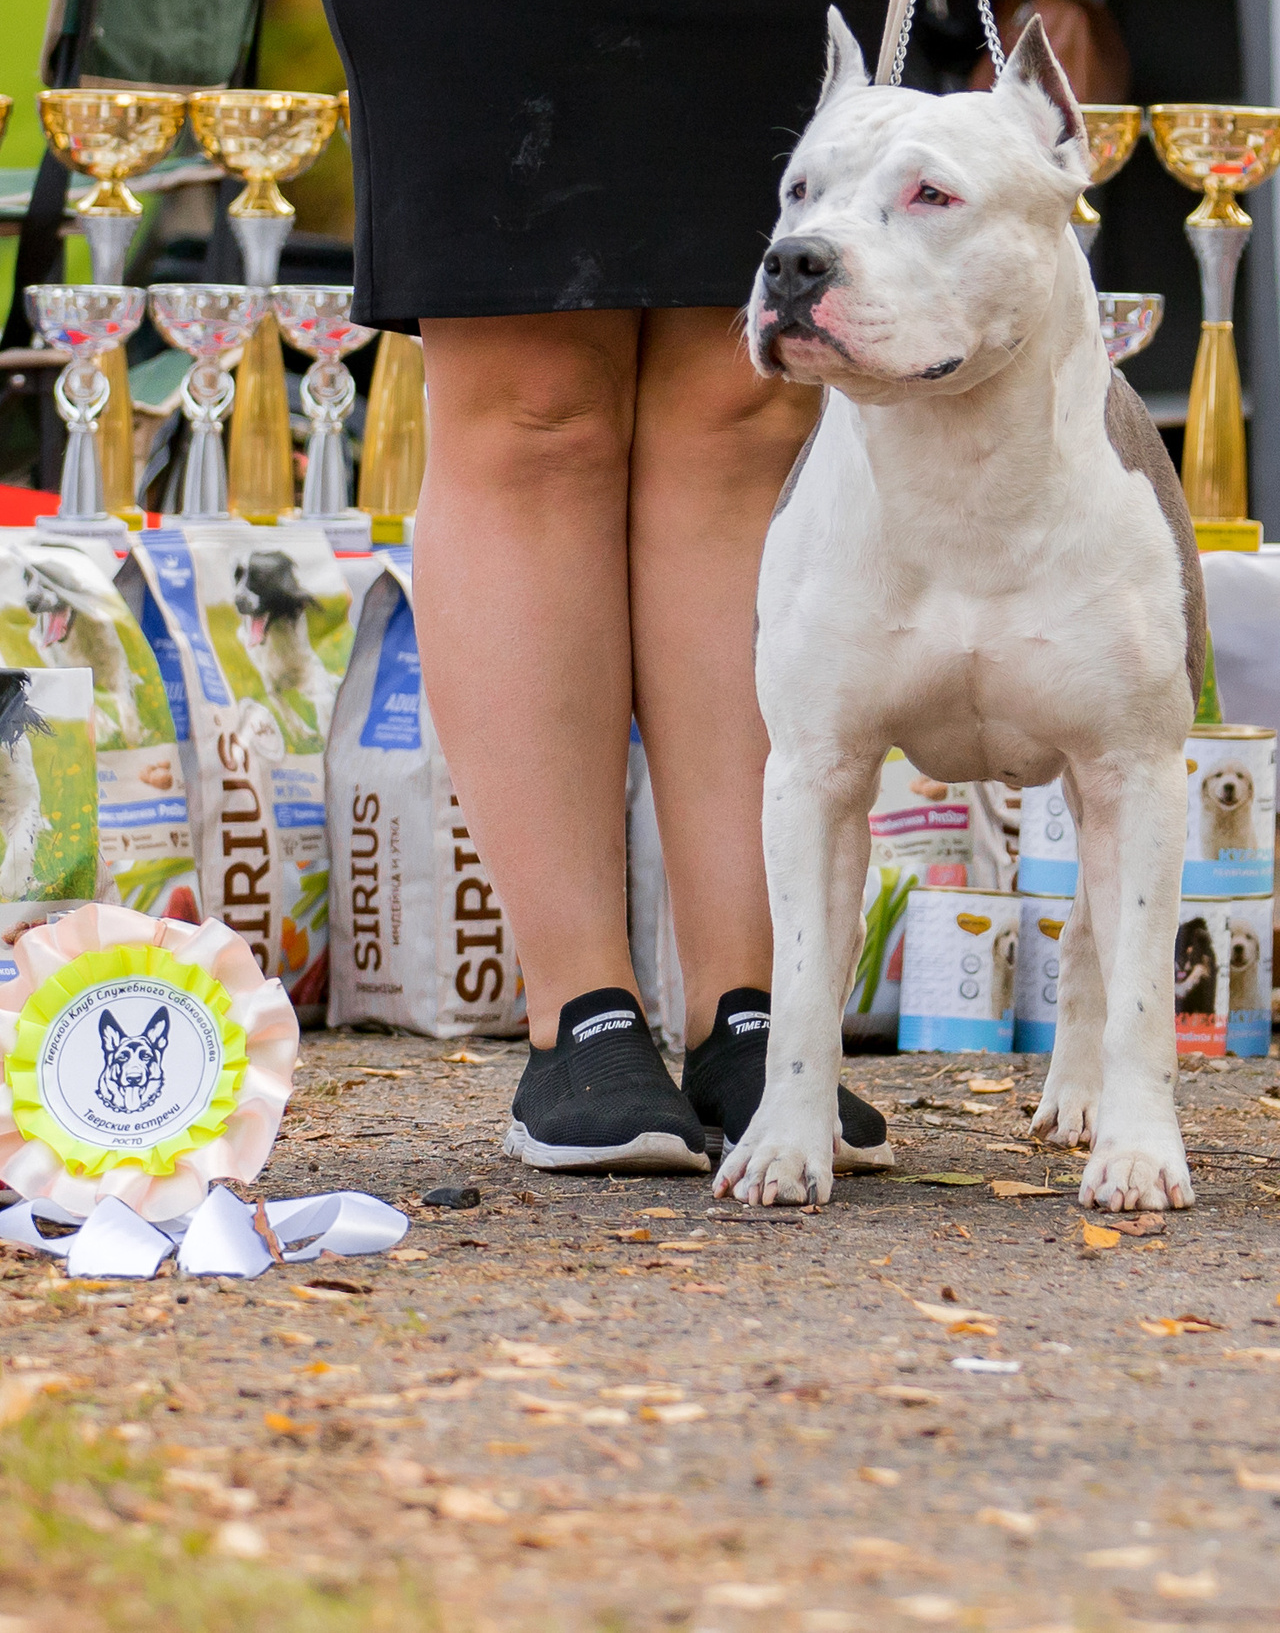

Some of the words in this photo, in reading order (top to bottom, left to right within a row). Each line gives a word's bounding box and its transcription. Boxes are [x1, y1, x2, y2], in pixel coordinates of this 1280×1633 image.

[352, 793, 382, 972] SIRIUS
[45, 1019, 69, 1066] Тверской
[68, 996, 95, 1020] Клуб
[96, 983, 166, 1002] Служебного
[167, 992, 216, 1063] Собаководства
[735, 1020, 761, 1035] TIME
[83, 1109, 131, 1132] Тверские
[134, 1103, 181, 1131] встречи
[112, 1137, 143, 1146] РОСТО
